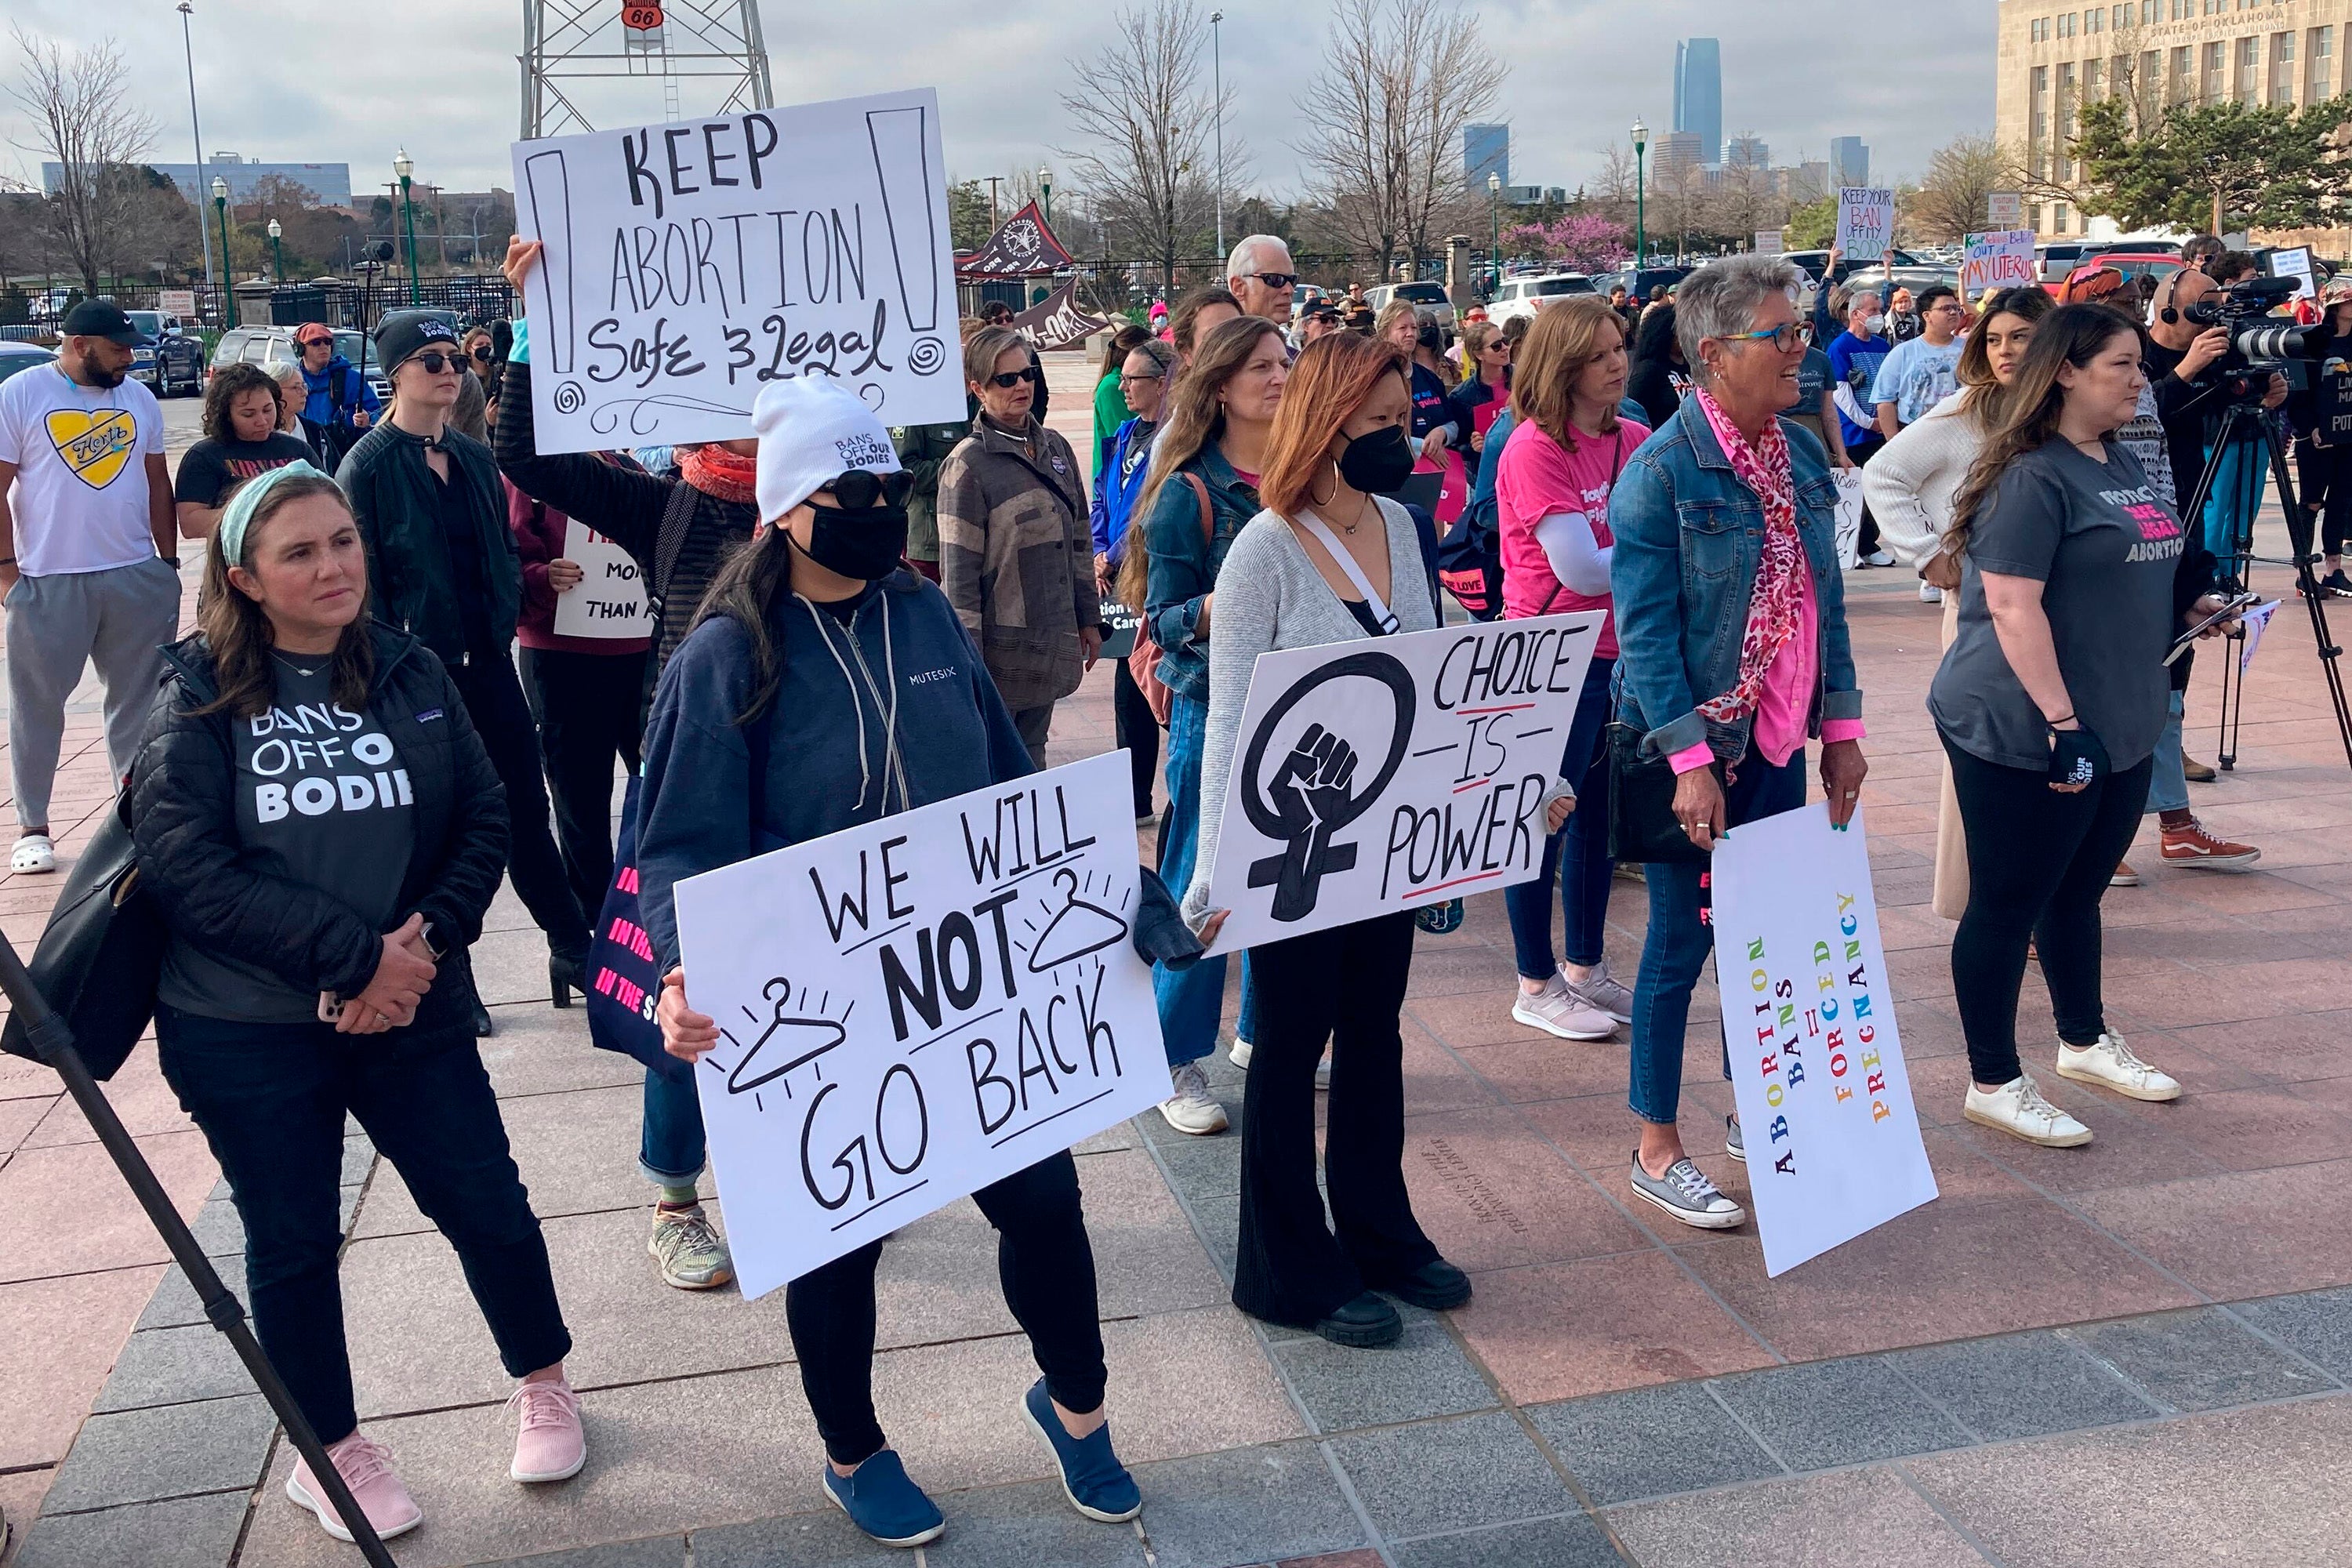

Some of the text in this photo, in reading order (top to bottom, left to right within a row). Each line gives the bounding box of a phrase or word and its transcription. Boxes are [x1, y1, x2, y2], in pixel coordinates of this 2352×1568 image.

[631, 9, 655, 25] 66
[2151, 8, 2284, 38] STATE OF OKLAHOMA
[623, 114, 779, 220] KEEP
[1842, 187, 1891, 206] KEEP YOUR
[1850, 206, 1882, 227] BAN
[1846, 224, 1882, 240] OFF MY
[611, 203, 865, 319] ABORTION
[1847, 238, 1889, 260] BODY
[1973, 245, 1994, 258] OUT
[1967, 255, 2034, 285] MY UTERUS
[587, 318, 707, 389] Safe
[757, 299, 894, 383] Legal
[835, 434, 874, 451] BANS
[840, 443, 891, 459] OFF OUR
[846, 454, 890, 470] BODIES
[2125, 537, 2184, 563] ABORTIO
[1456, 579, 1483, 591] LOVE
[586, 601, 637, 619] THAN
[1099, 601, 1125, 616] tion
[1112, 617, 1142, 630] Care
[909, 666, 956, 686] MUTESIX
[1434, 625, 1590, 710] CHOICE
[250, 702, 363, 737] BANS
[251, 736, 345, 776] OFF
[1453, 713, 1514, 785] IS
[2076, 757, 2086, 780] OUR
[1380, 773, 1546, 901] POWER
[809, 786, 1095, 943] WE WILL
[608, 916, 633, 946] IN
[880, 890, 1018, 1042] NOT
[595, 967, 618, 996] IN
[615, 976, 644, 1014] THE
[1813, 940, 1854, 1104] FORCED
[1836, 891, 1891, 1123] PREGNANCY
[1775, 978, 1806, 1089] BANS
[1748, 935, 1796, 1175] ABORTION
[800, 964, 1122, 1210] GO BACK
